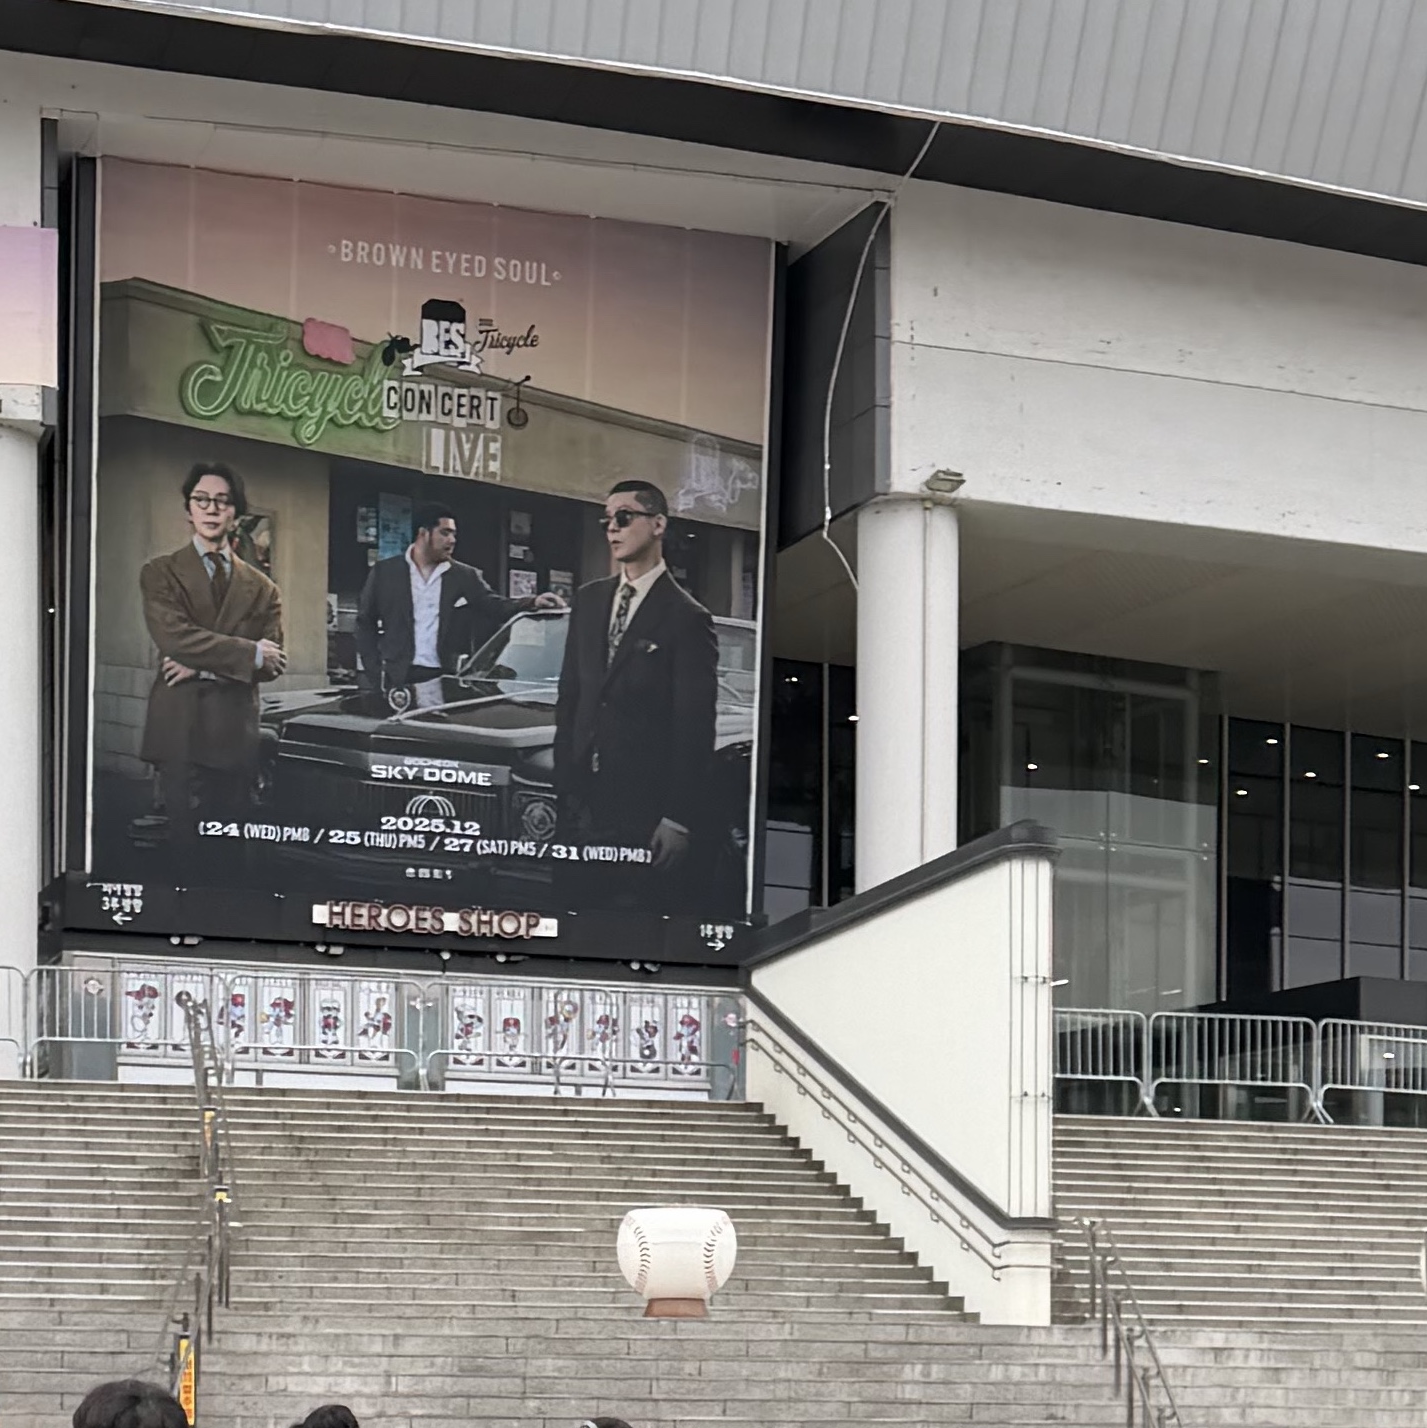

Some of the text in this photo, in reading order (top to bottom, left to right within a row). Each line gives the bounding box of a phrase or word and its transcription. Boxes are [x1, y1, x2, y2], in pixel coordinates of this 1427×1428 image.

[340, 239, 552, 286] BROWN EYED SOUL
[422, 318, 466, 358] BES
[471, 324, 540, 355] Tricycle
[184, 318, 402, 446] Tricycl
[386, 385, 499, 422] CONCERT
[423, 427, 502, 480] LIVE
[370, 764, 492, 787] SKY DOME
[328, 830, 362, 845] 25
[443, 838, 474, 852] 27
[551, 844, 580, 859] 31
[380, 816, 481, 836] 2025.12
[325, 900, 542, 941] HEROES SHOP
